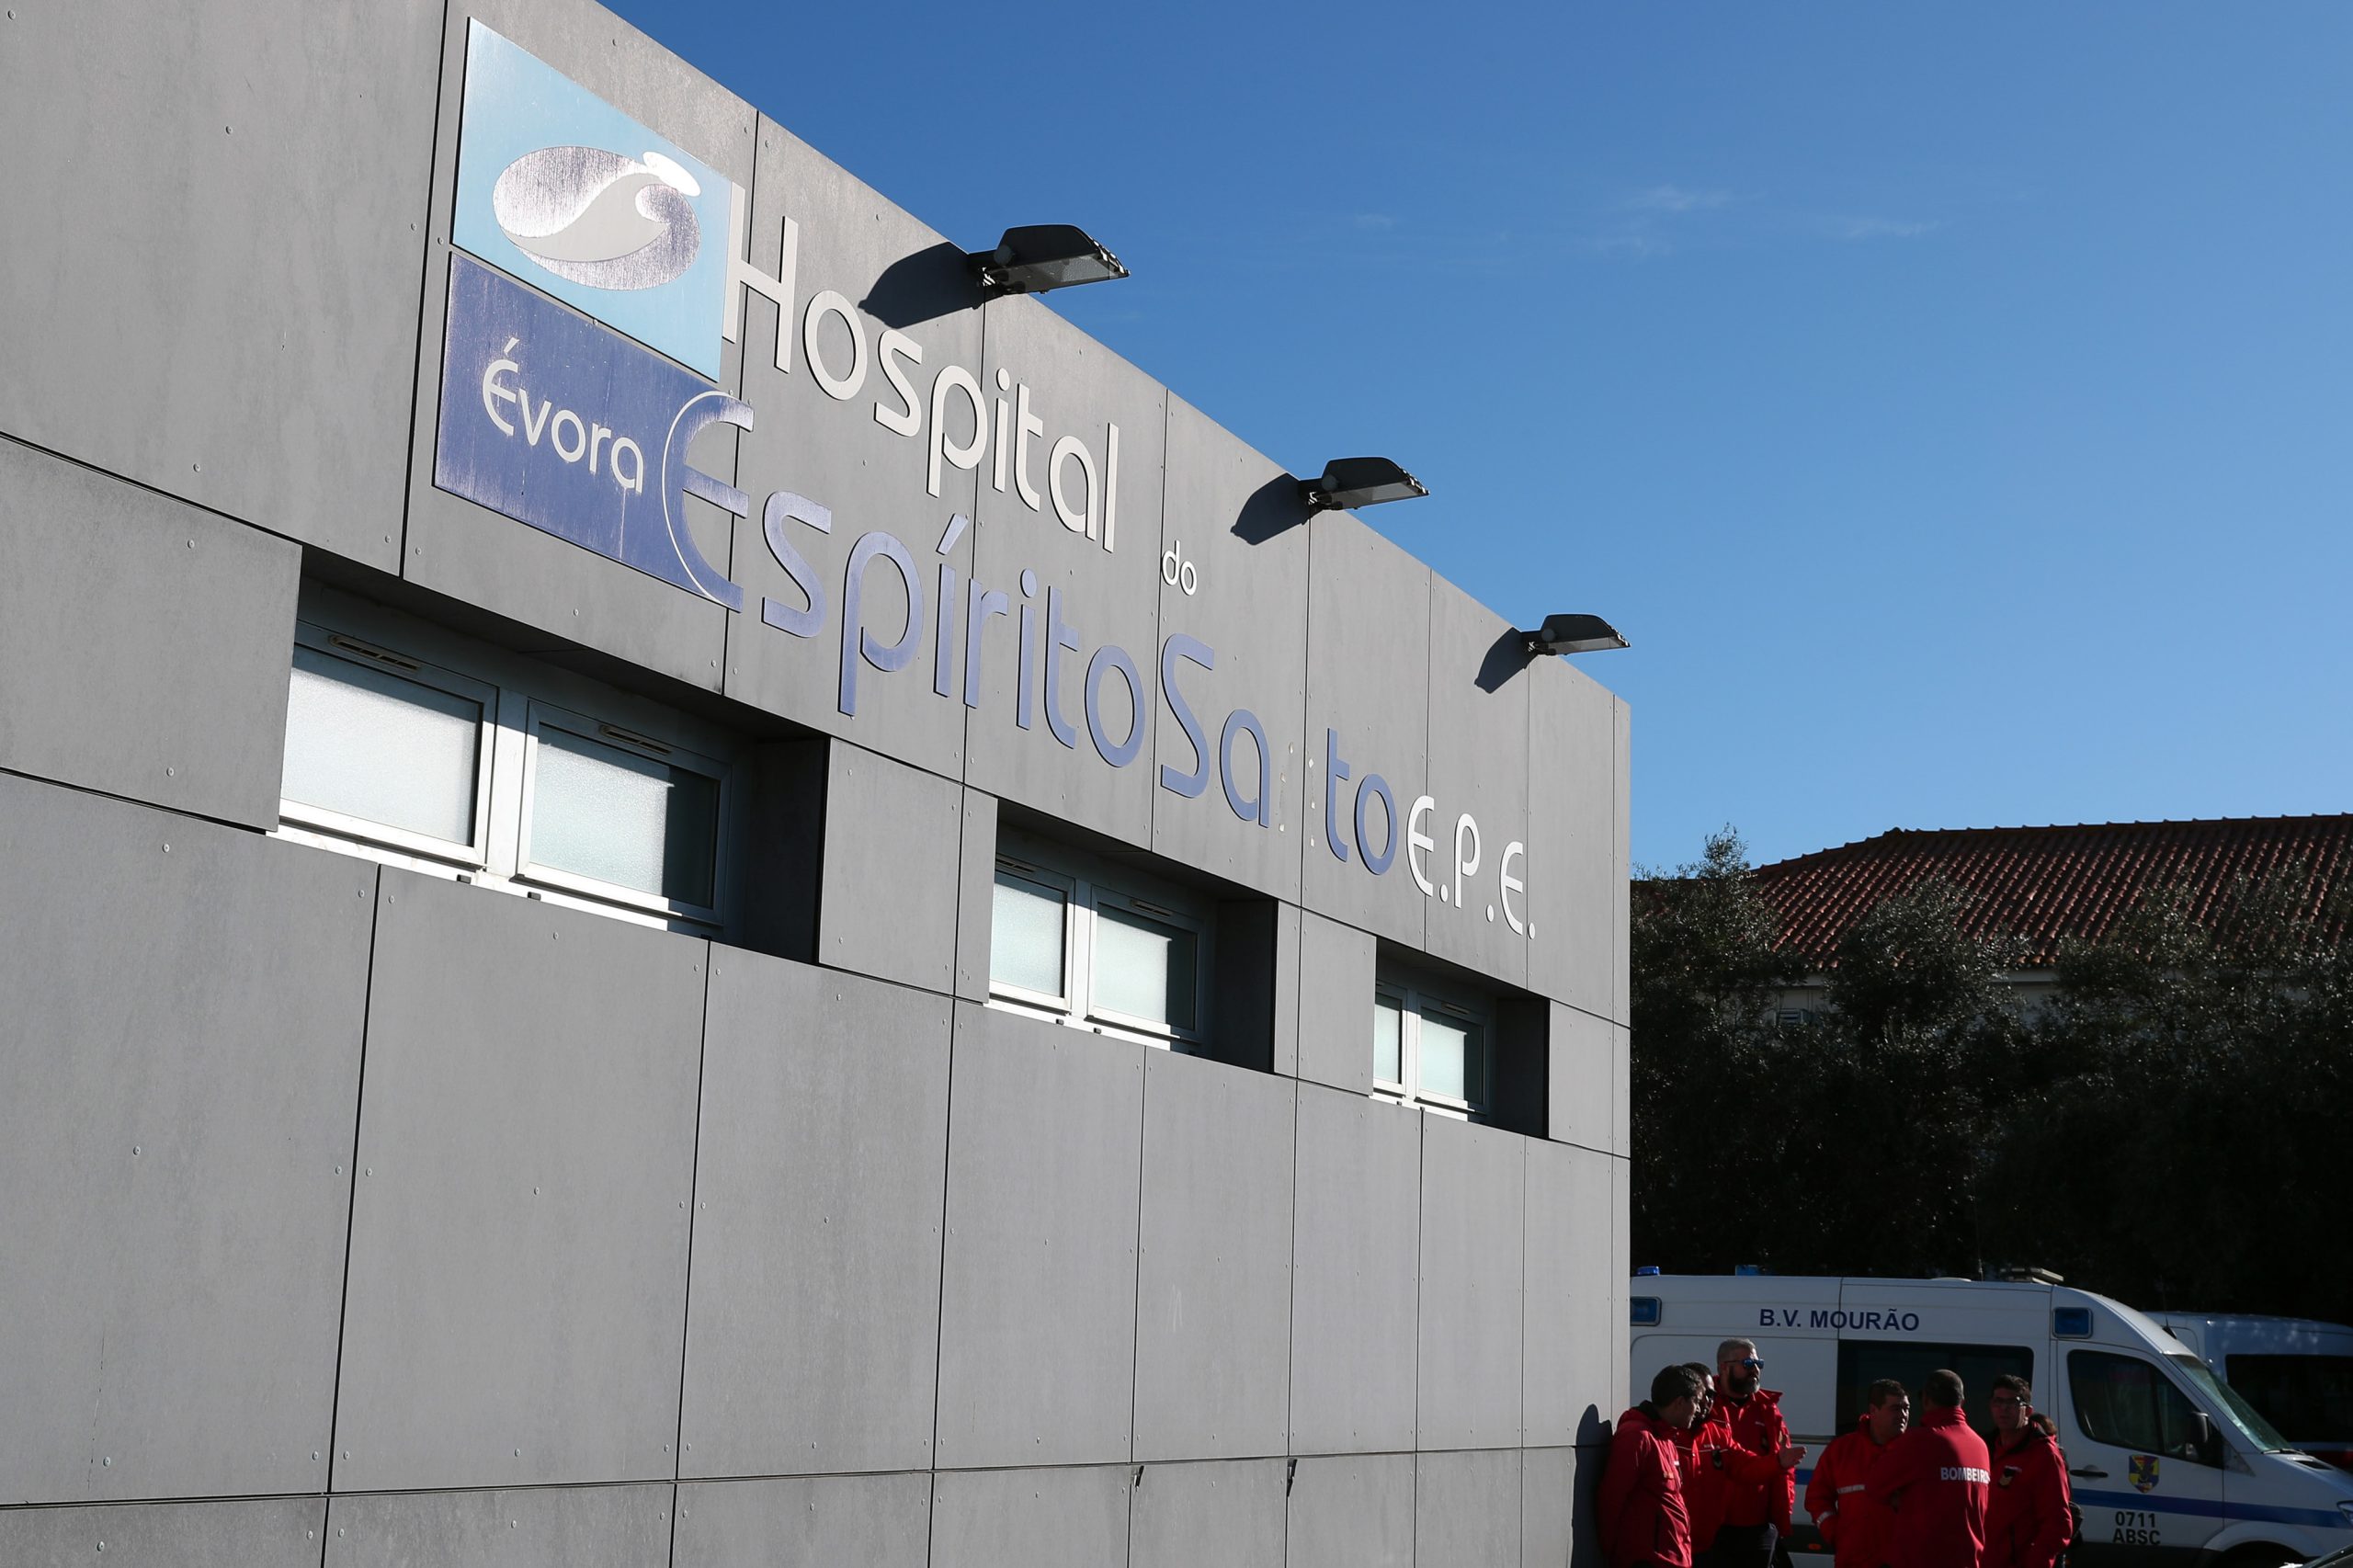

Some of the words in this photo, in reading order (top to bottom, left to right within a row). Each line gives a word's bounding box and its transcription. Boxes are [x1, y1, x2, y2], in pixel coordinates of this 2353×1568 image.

[722, 182, 1120, 553] Hospital
[483, 336, 644, 494] Évora
[1162, 540, 1197, 596] do
[1161, 632, 1397, 876] Sato
[1759, 1308, 1802, 1327] B.V.
[1810, 1308, 1920, 1332] MOURÃO
[2113, 1528, 2161, 1545] ABSC
[2115, 1511, 2156, 1528] 0711
